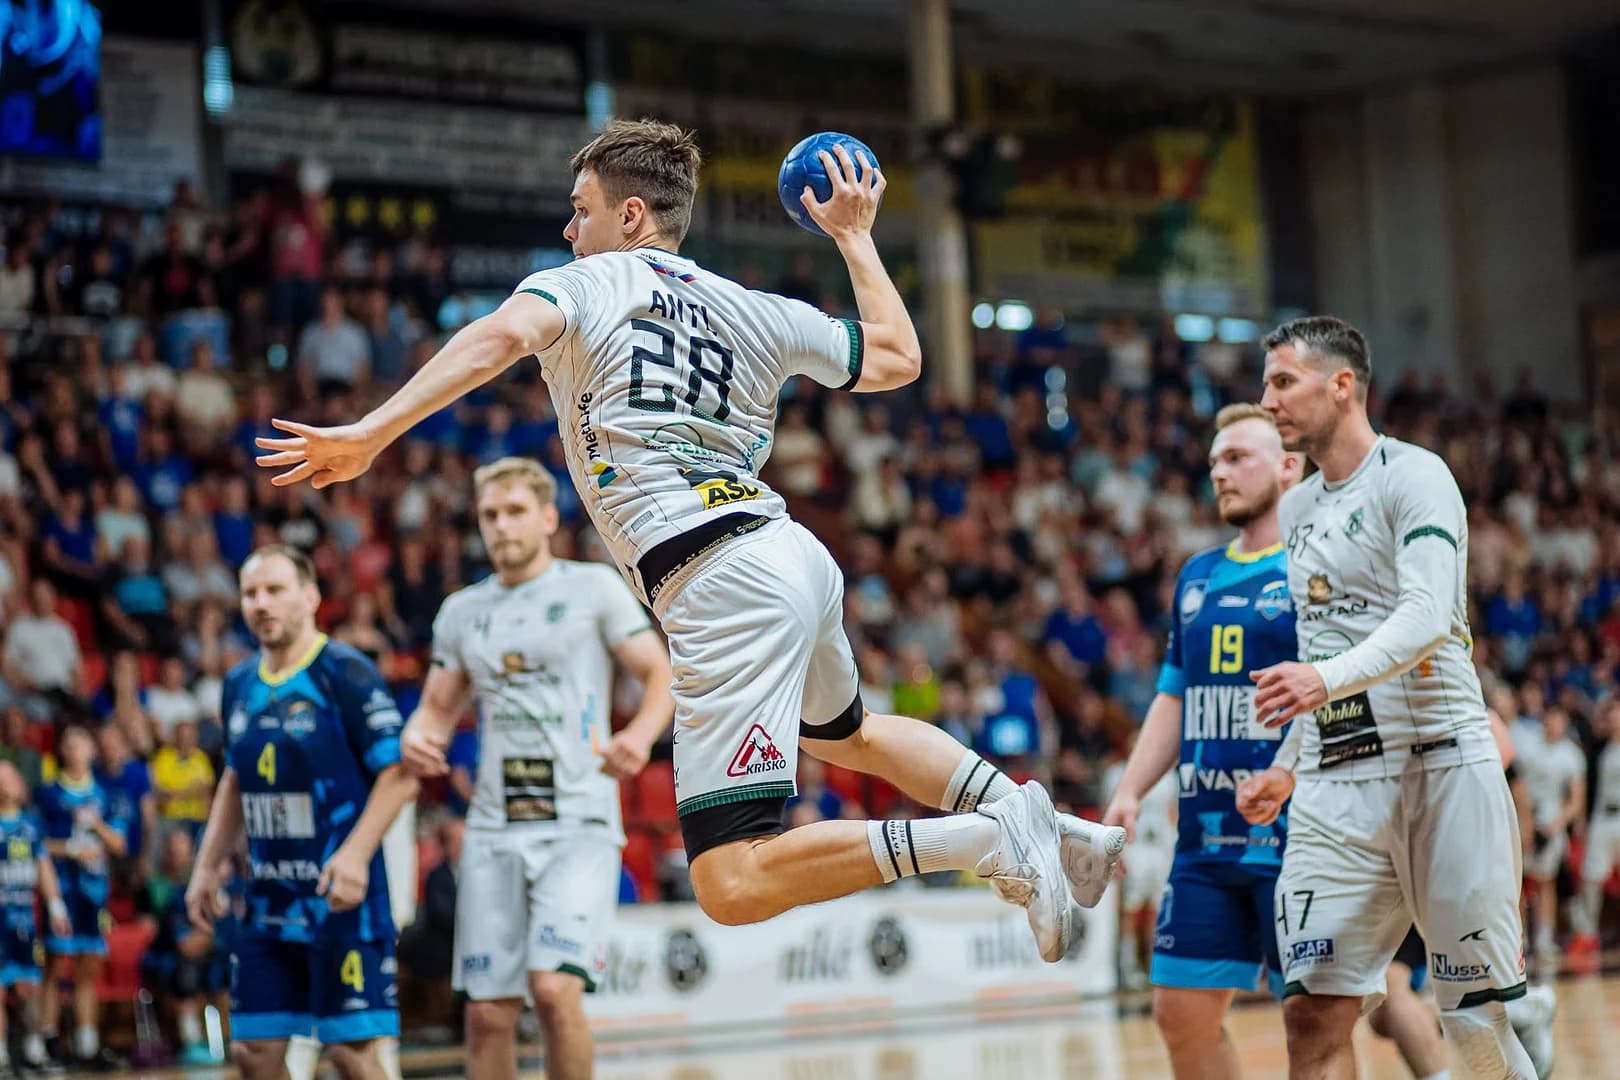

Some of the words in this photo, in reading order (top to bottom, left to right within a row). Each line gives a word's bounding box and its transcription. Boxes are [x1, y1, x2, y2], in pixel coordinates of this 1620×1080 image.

[627, 318, 734, 424] 28
[577, 391, 601, 461] MetLife
[1287, 523, 1314, 559] 47
[1210, 624, 1244, 674] 19
[1323, 701, 1364, 725] Dukla
[257, 742, 276, 785] 4
[745, 759, 787, 776] KRISKO
[340, 949, 364, 992] 4
